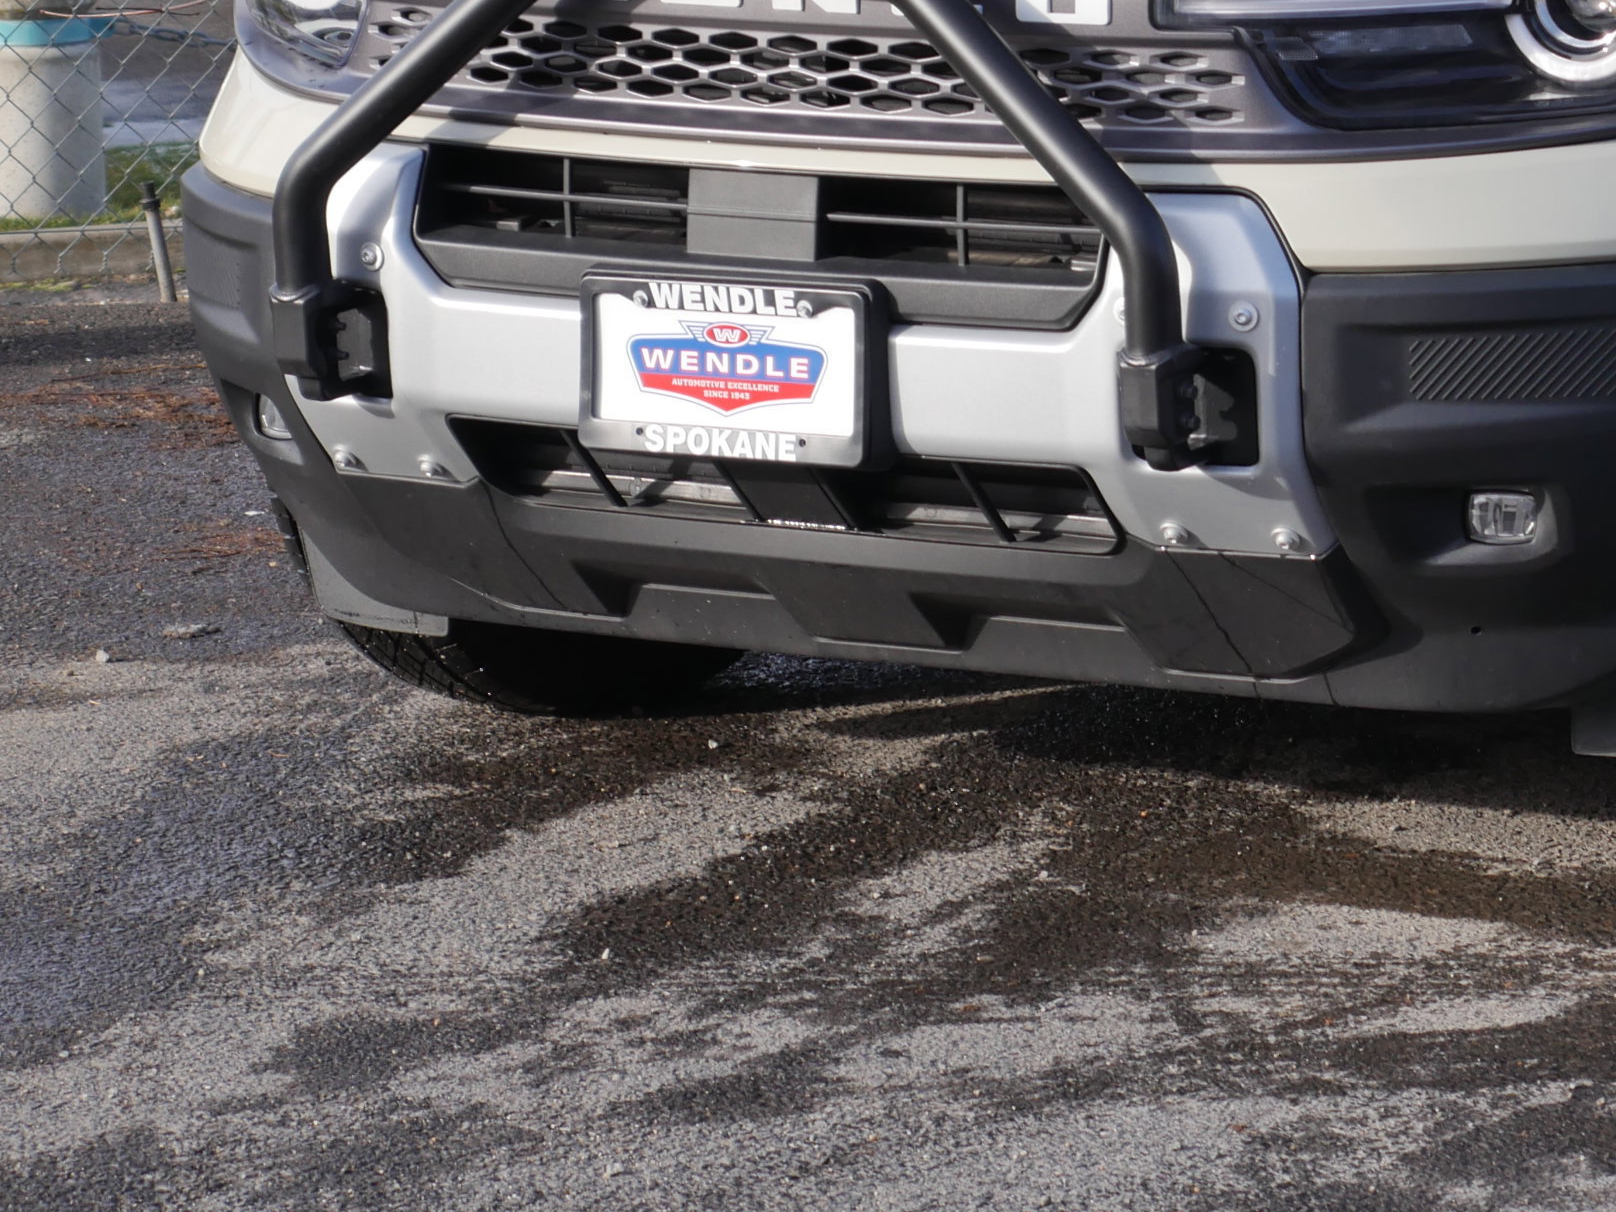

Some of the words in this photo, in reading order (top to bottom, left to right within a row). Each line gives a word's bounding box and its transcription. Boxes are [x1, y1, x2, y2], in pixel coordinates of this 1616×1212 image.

[648, 282, 798, 316] WENDLE
[640, 347, 809, 379] WENDLE
[672, 378, 725, 389] AUTOMOTIVE
[727, 381, 779, 393] EXCELLENCE
[703, 390, 729, 399] SINCE
[643, 423, 797, 462] SPOKANE
